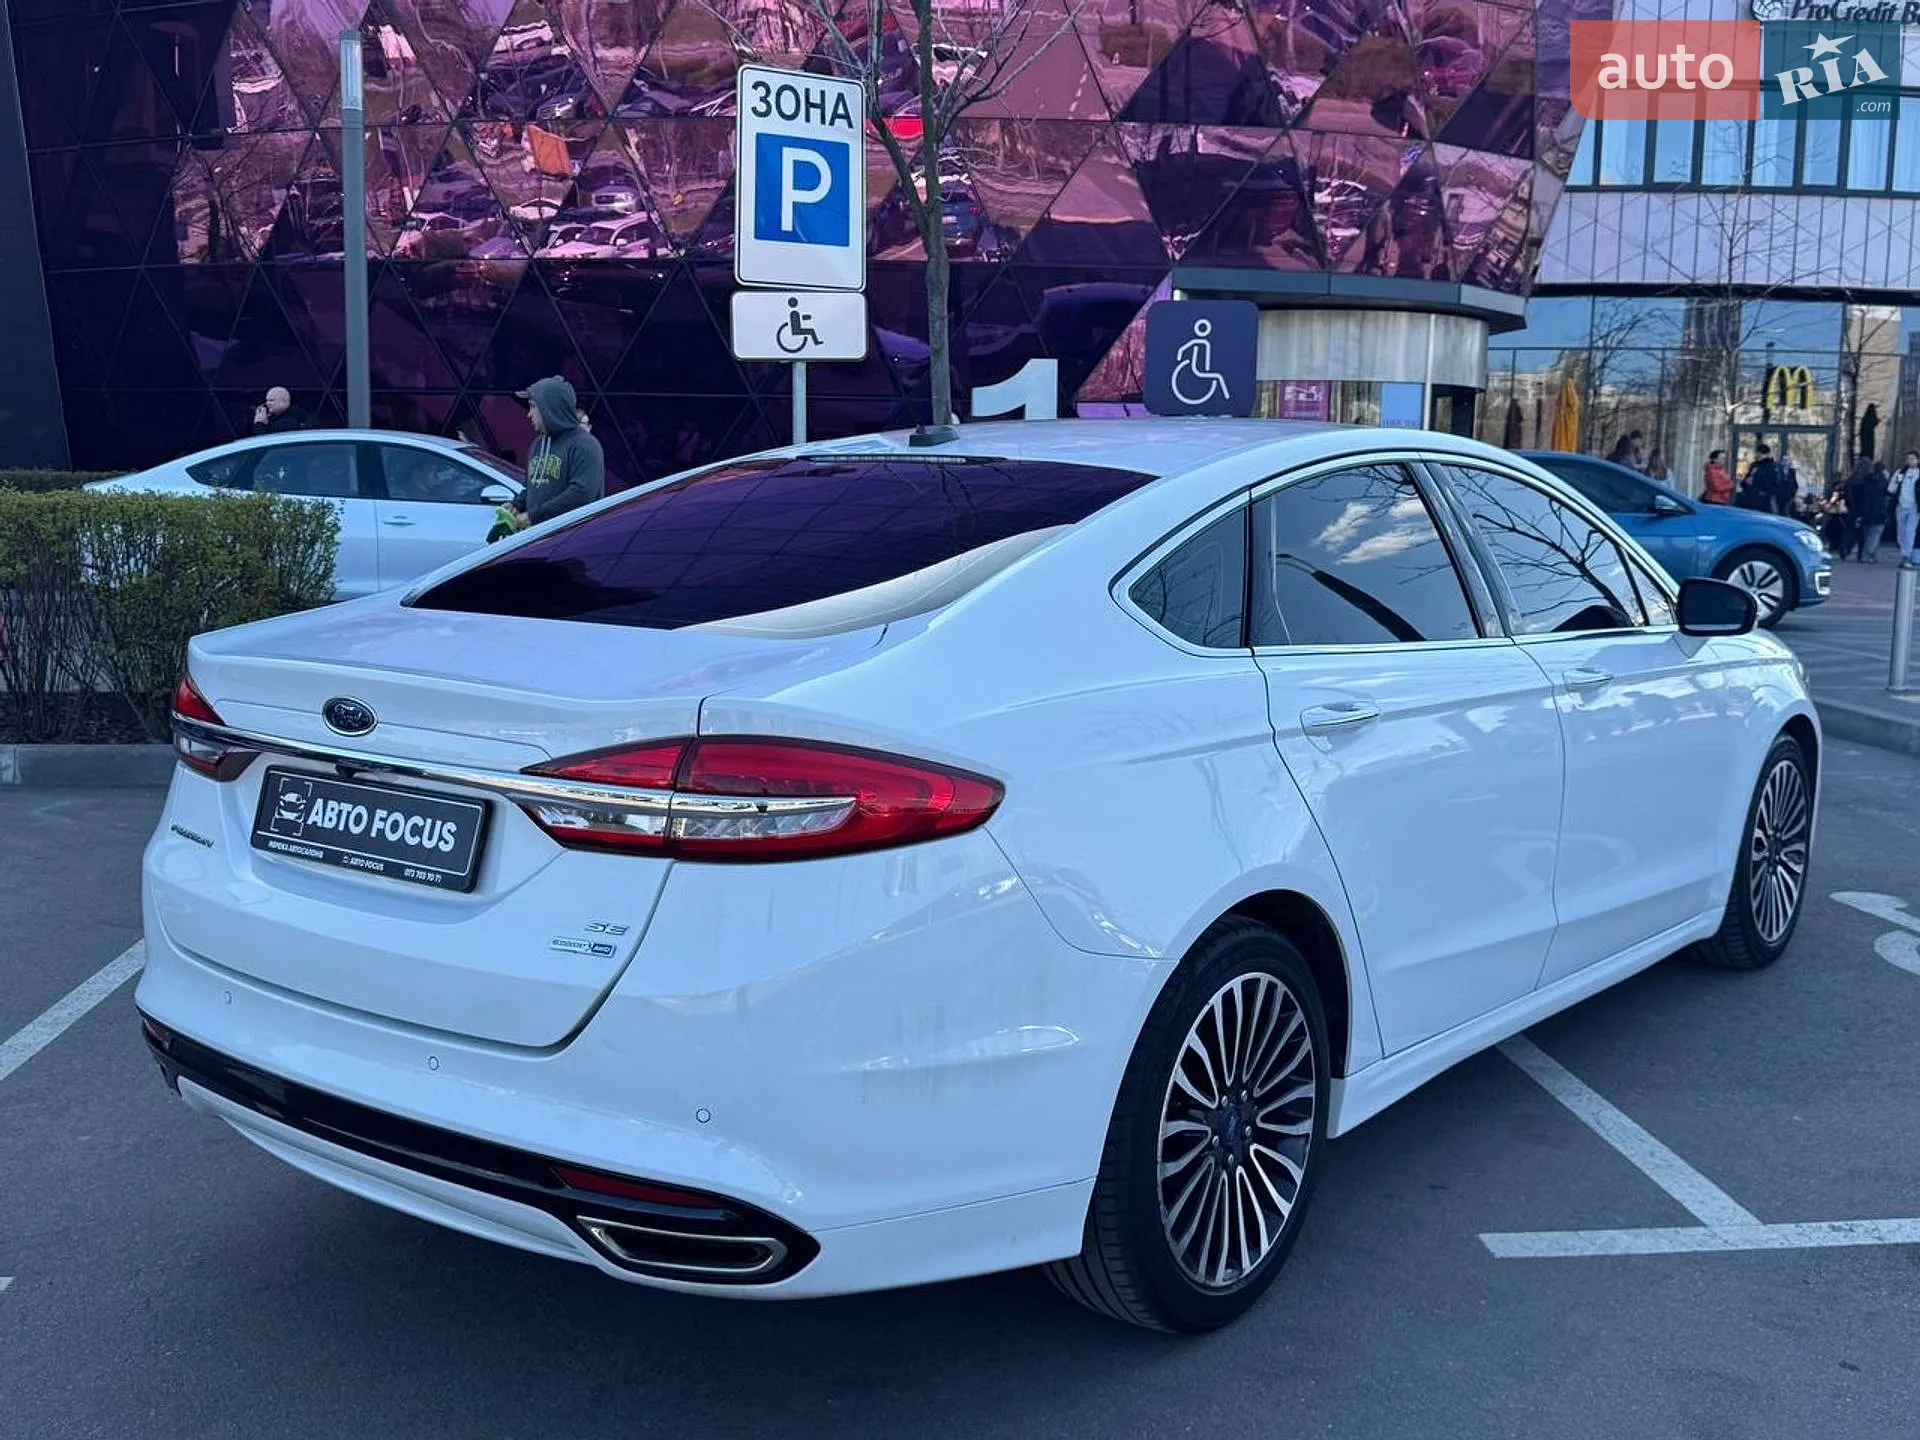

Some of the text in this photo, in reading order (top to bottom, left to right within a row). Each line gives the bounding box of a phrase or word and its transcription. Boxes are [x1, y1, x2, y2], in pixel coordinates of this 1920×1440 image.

[1792, 0, 1920, 25] ProCredit B
[751, 80, 854, 129] ЗОНА
[781, 146, 832, 232] P
[370, 808, 458, 852] FOCUS
